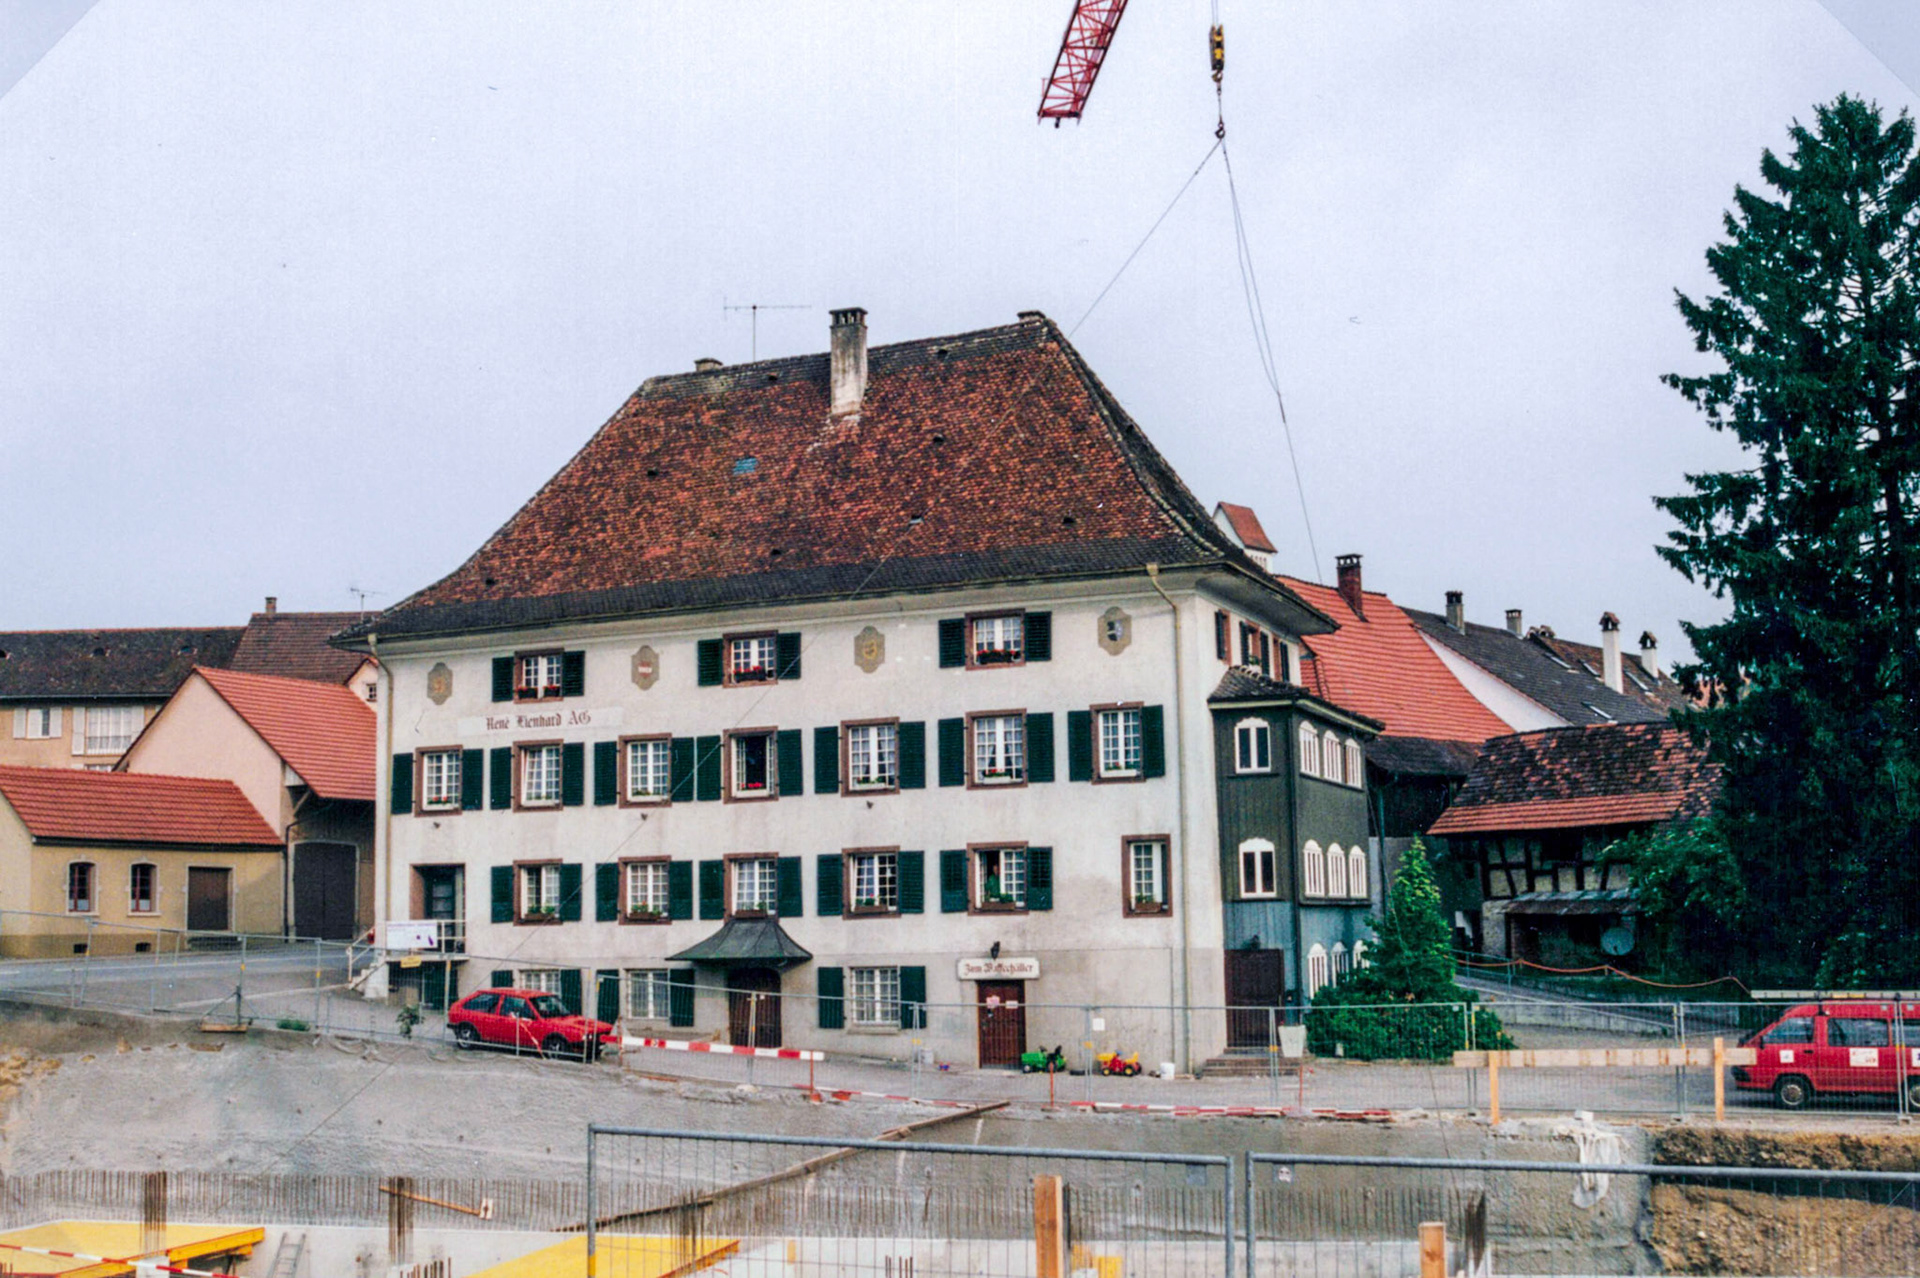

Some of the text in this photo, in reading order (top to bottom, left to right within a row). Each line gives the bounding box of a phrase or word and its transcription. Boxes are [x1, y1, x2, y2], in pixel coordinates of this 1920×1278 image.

[515, 712, 562, 728] Lienhard
[567, 710, 591, 725] AG
[964, 963, 982, 976] Zum
